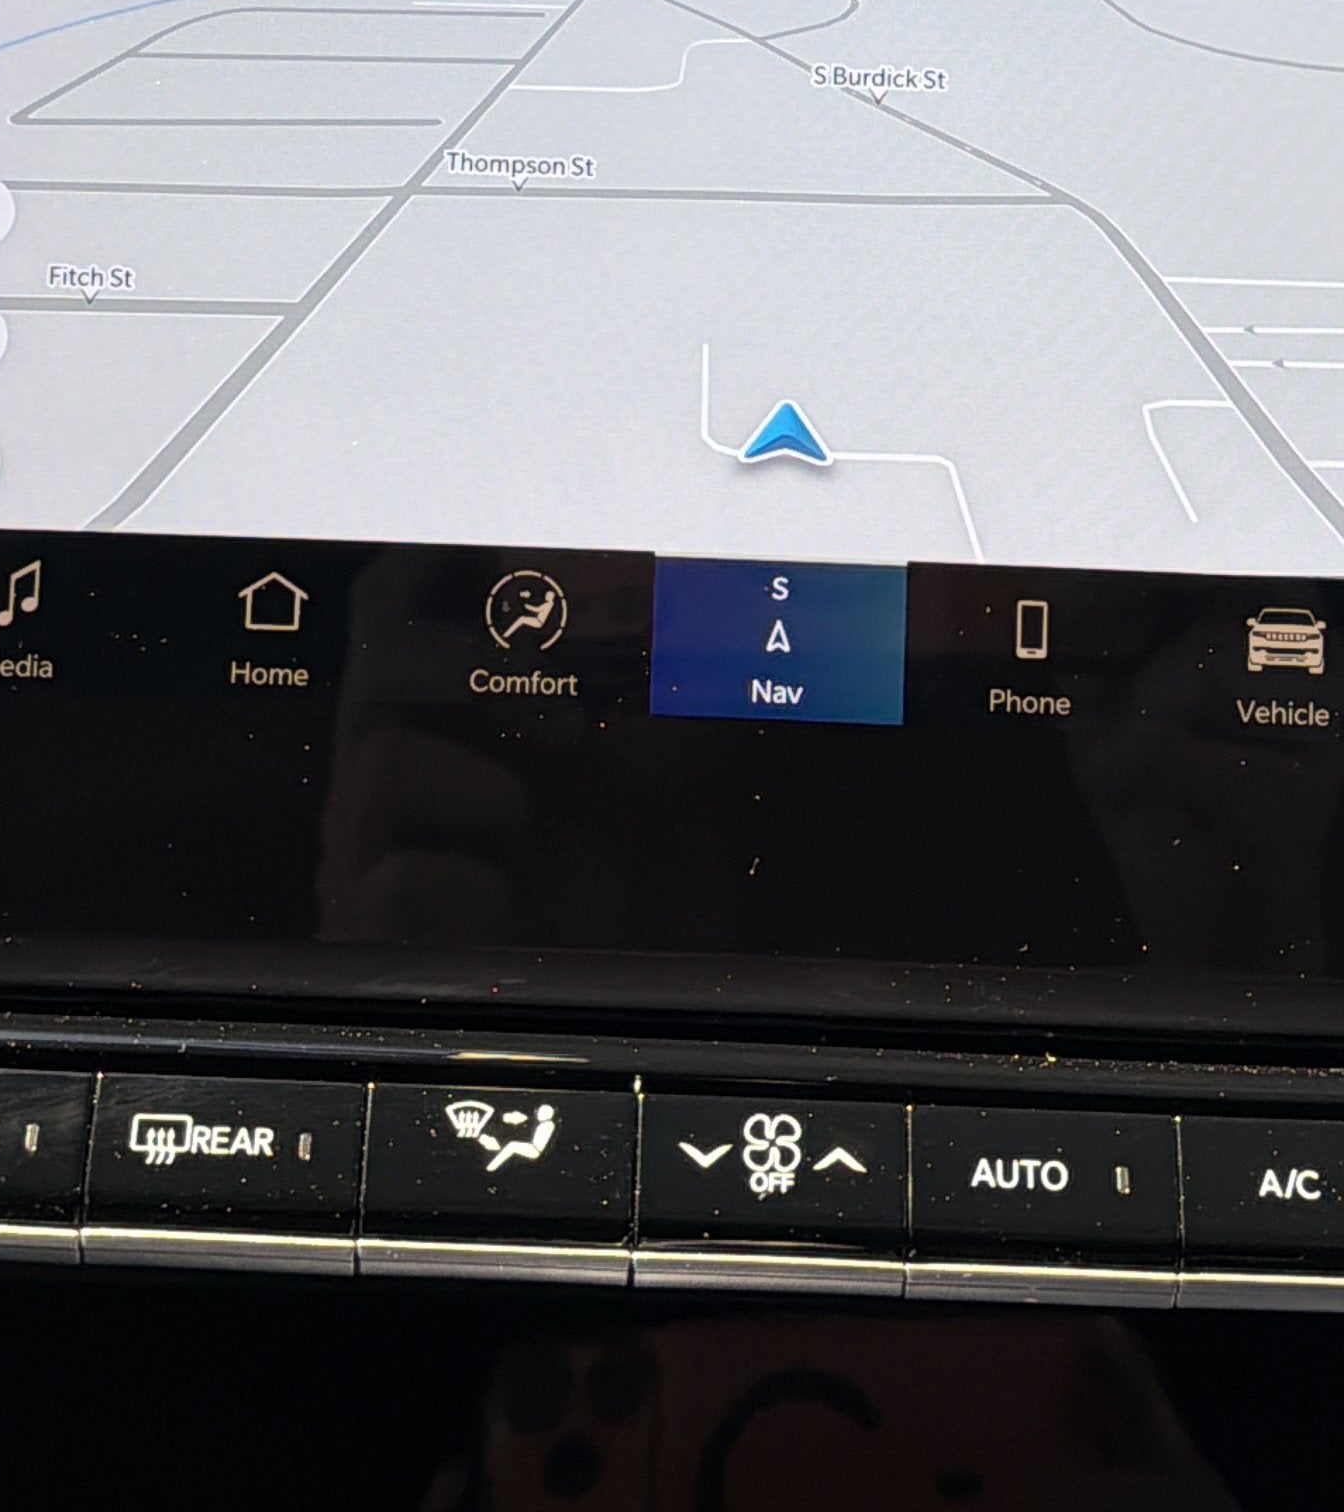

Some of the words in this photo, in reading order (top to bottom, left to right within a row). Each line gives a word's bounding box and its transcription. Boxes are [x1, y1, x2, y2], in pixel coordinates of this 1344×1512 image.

[813, 67, 828, 88] S
[832, 67, 916, 89] Burdick
[922, 69, 947, 90] St
[446, 151, 566, 177] Thompson
[571, 156, 594, 177] St
[49, 266, 103, 287] Fitch
[110, 268, 133, 288] St
[771, 578, 789, 602] S
[230, 661, 308, 686] Home
[469, 670, 578, 696] Comfort
[751, 680, 803, 706] Nav
[989, 689, 1071, 717] Phone
[1237, 699, 1330, 728] Vehicle
[191, 1125, 273, 1157] REAR
[749, 1172, 795, 1193] OFF
[972, 1159, 1068, 1192] AUTO
[1260, 1169, 1321, 1201] A/C
